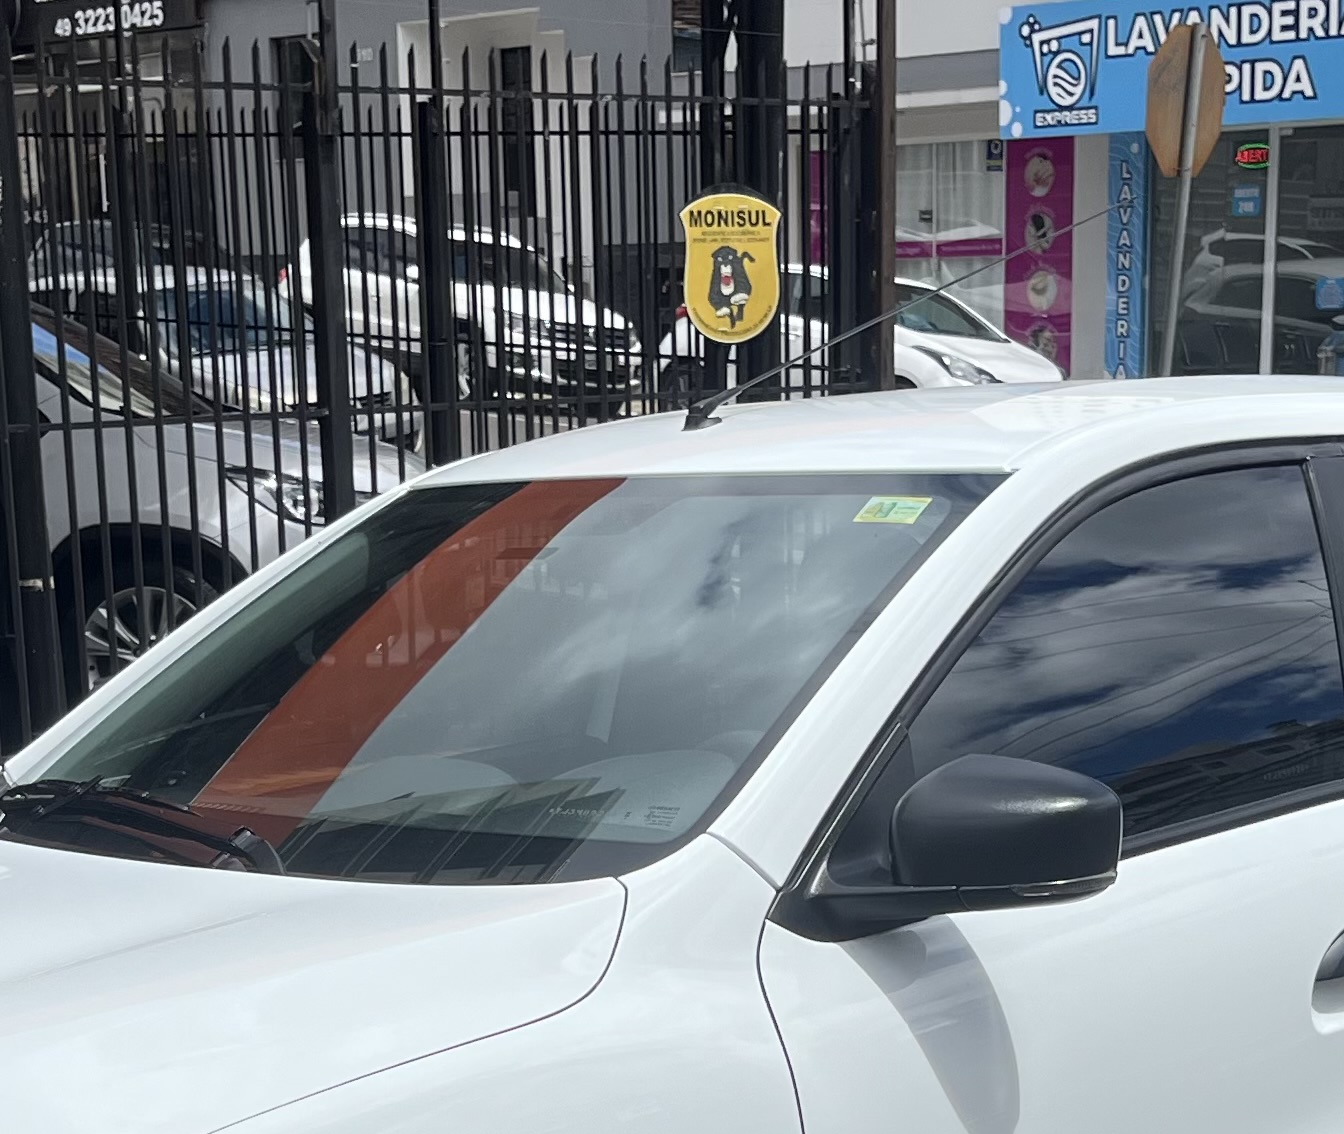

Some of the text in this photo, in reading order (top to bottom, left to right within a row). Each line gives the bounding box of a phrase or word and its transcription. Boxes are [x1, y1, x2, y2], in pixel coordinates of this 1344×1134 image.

[74, 6, 116, 36] 3223
[120, 1, 164, 30] 0425
[1034, 109, 1097, 127] EXPRESS
[689, 210, 772, 228] MONISUL
[1116, 160, 1133, 379] LAVANDERIA
